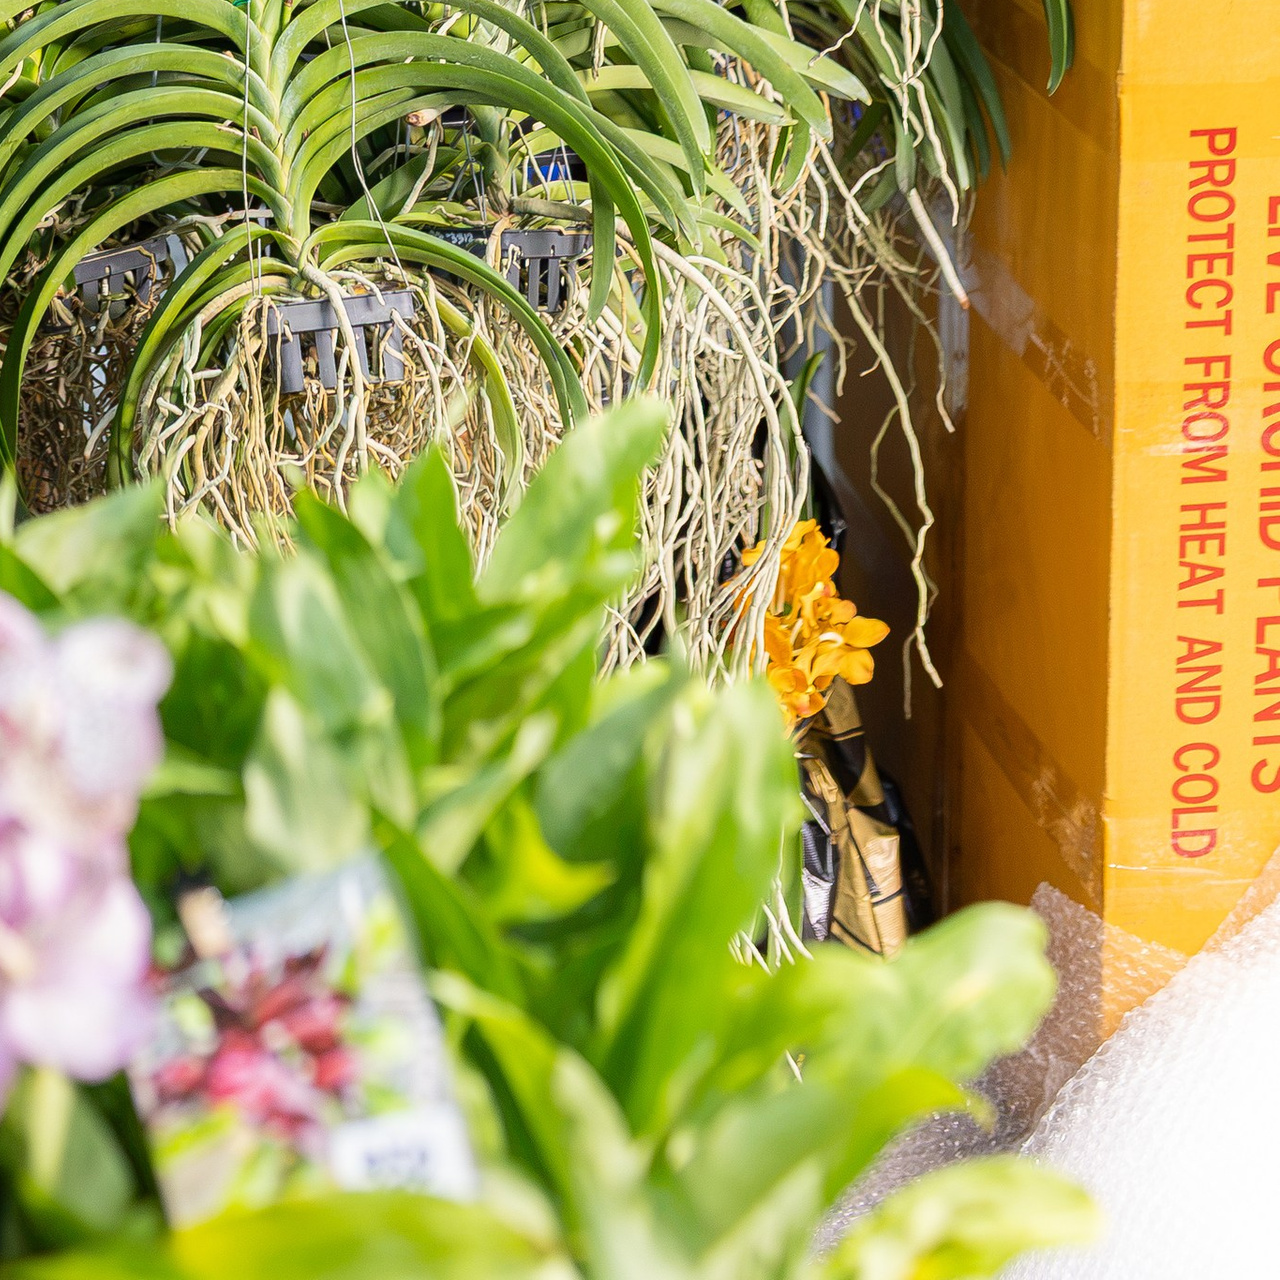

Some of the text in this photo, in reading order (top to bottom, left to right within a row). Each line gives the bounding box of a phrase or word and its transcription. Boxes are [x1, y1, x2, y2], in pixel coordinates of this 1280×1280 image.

[1170, 126, 1237, 859] PROTECT FROM HEAT AND COLD
